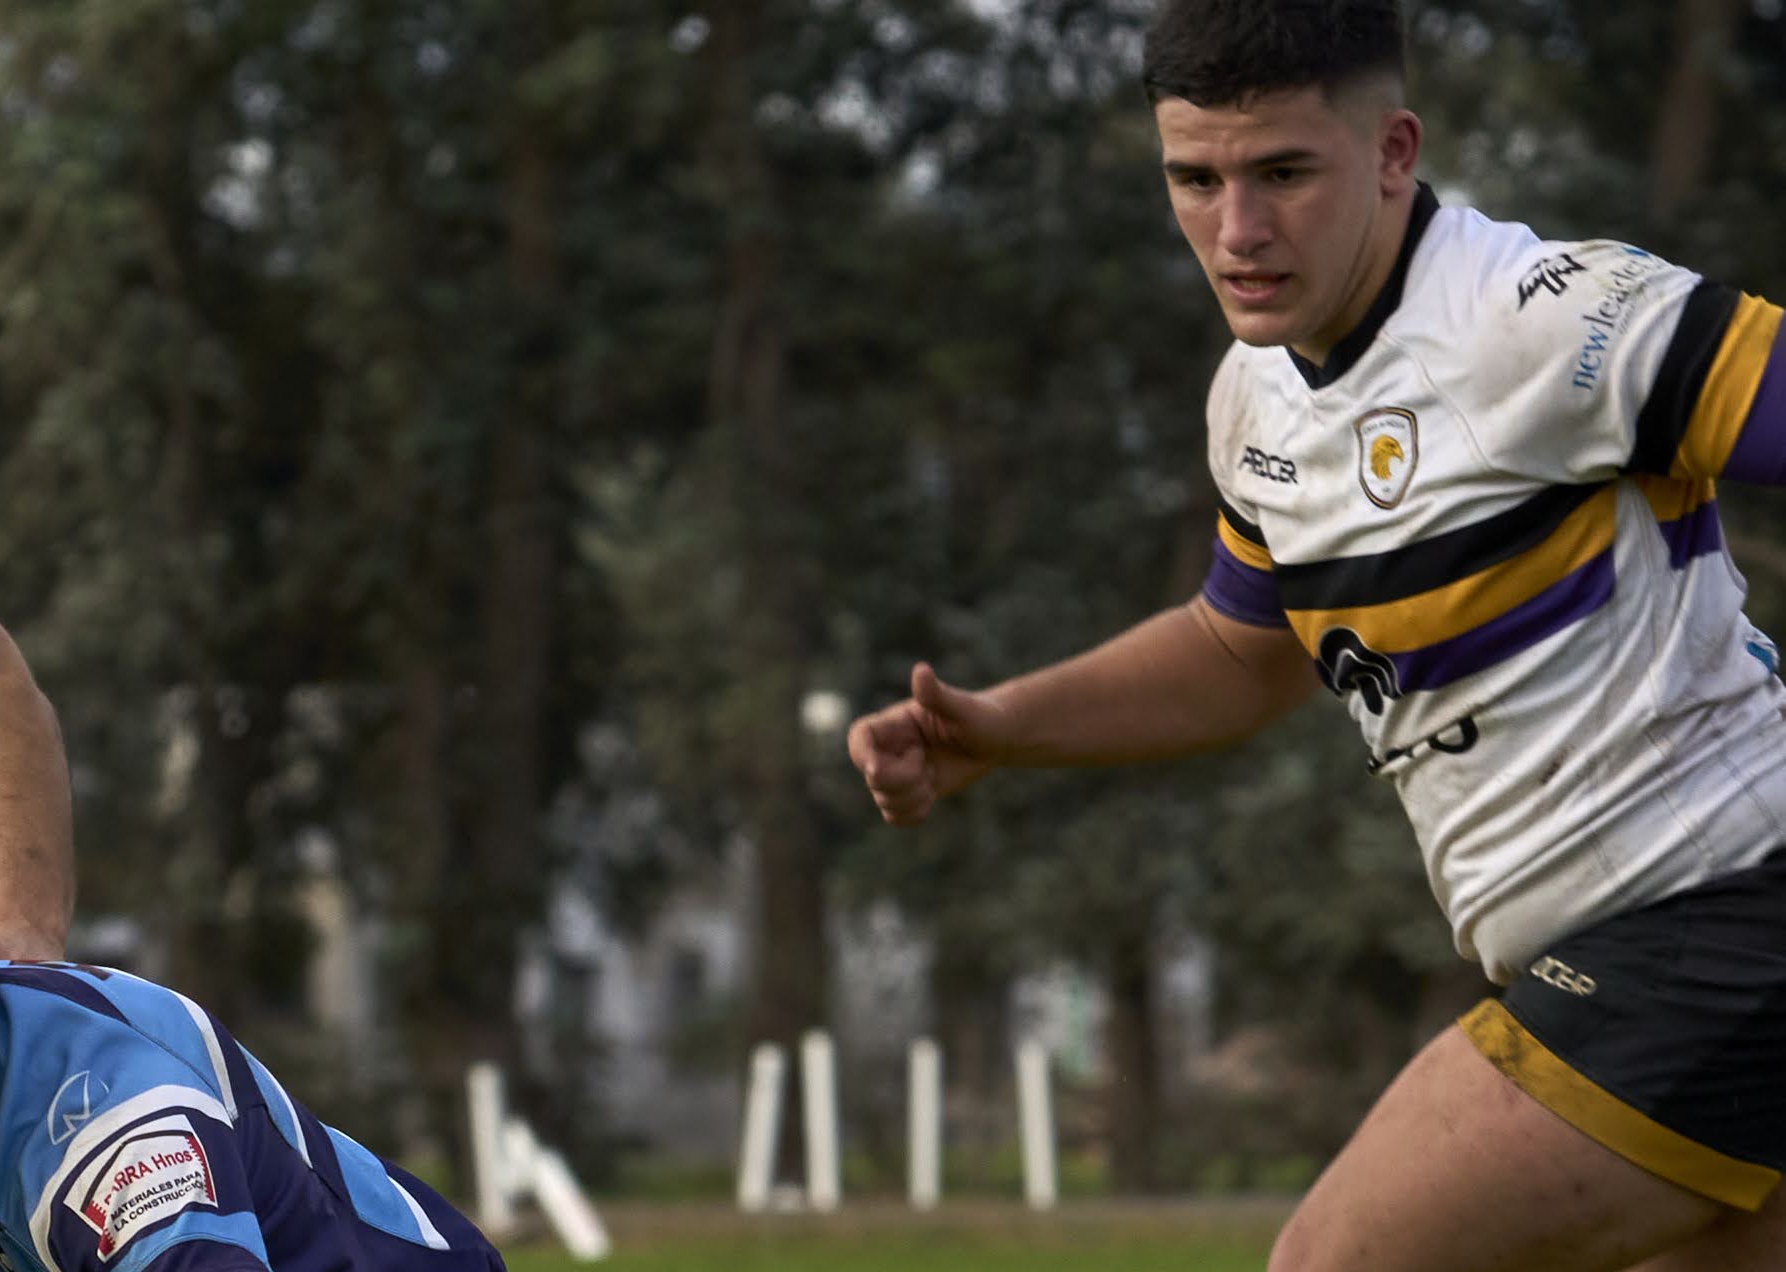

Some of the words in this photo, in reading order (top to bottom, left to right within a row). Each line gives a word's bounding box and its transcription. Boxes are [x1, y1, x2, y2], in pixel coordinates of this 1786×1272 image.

[150, 1150, 194, 1171] Hnos
[110, 1180, 174, 1221] MATERIALES
[174, 1170, 203, 1187] PARA
[114, 1217, 130, 1233] LA
